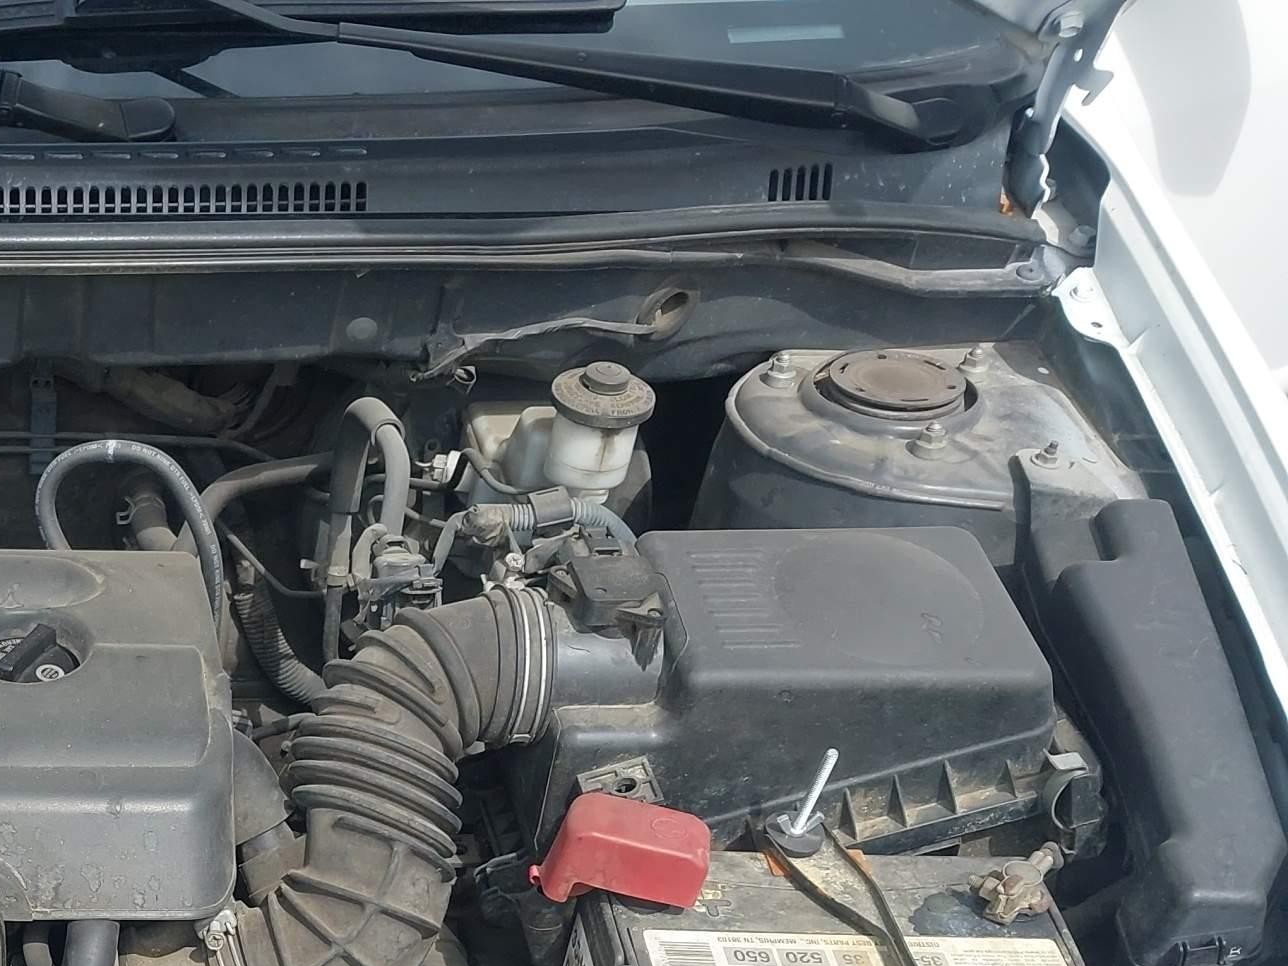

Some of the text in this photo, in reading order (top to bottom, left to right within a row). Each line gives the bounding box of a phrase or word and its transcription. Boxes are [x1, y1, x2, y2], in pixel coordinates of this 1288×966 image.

[734, 949, 769, 962] 650
[785, 951, 822, 963] 520
[842, 954, 863, 966] 35
